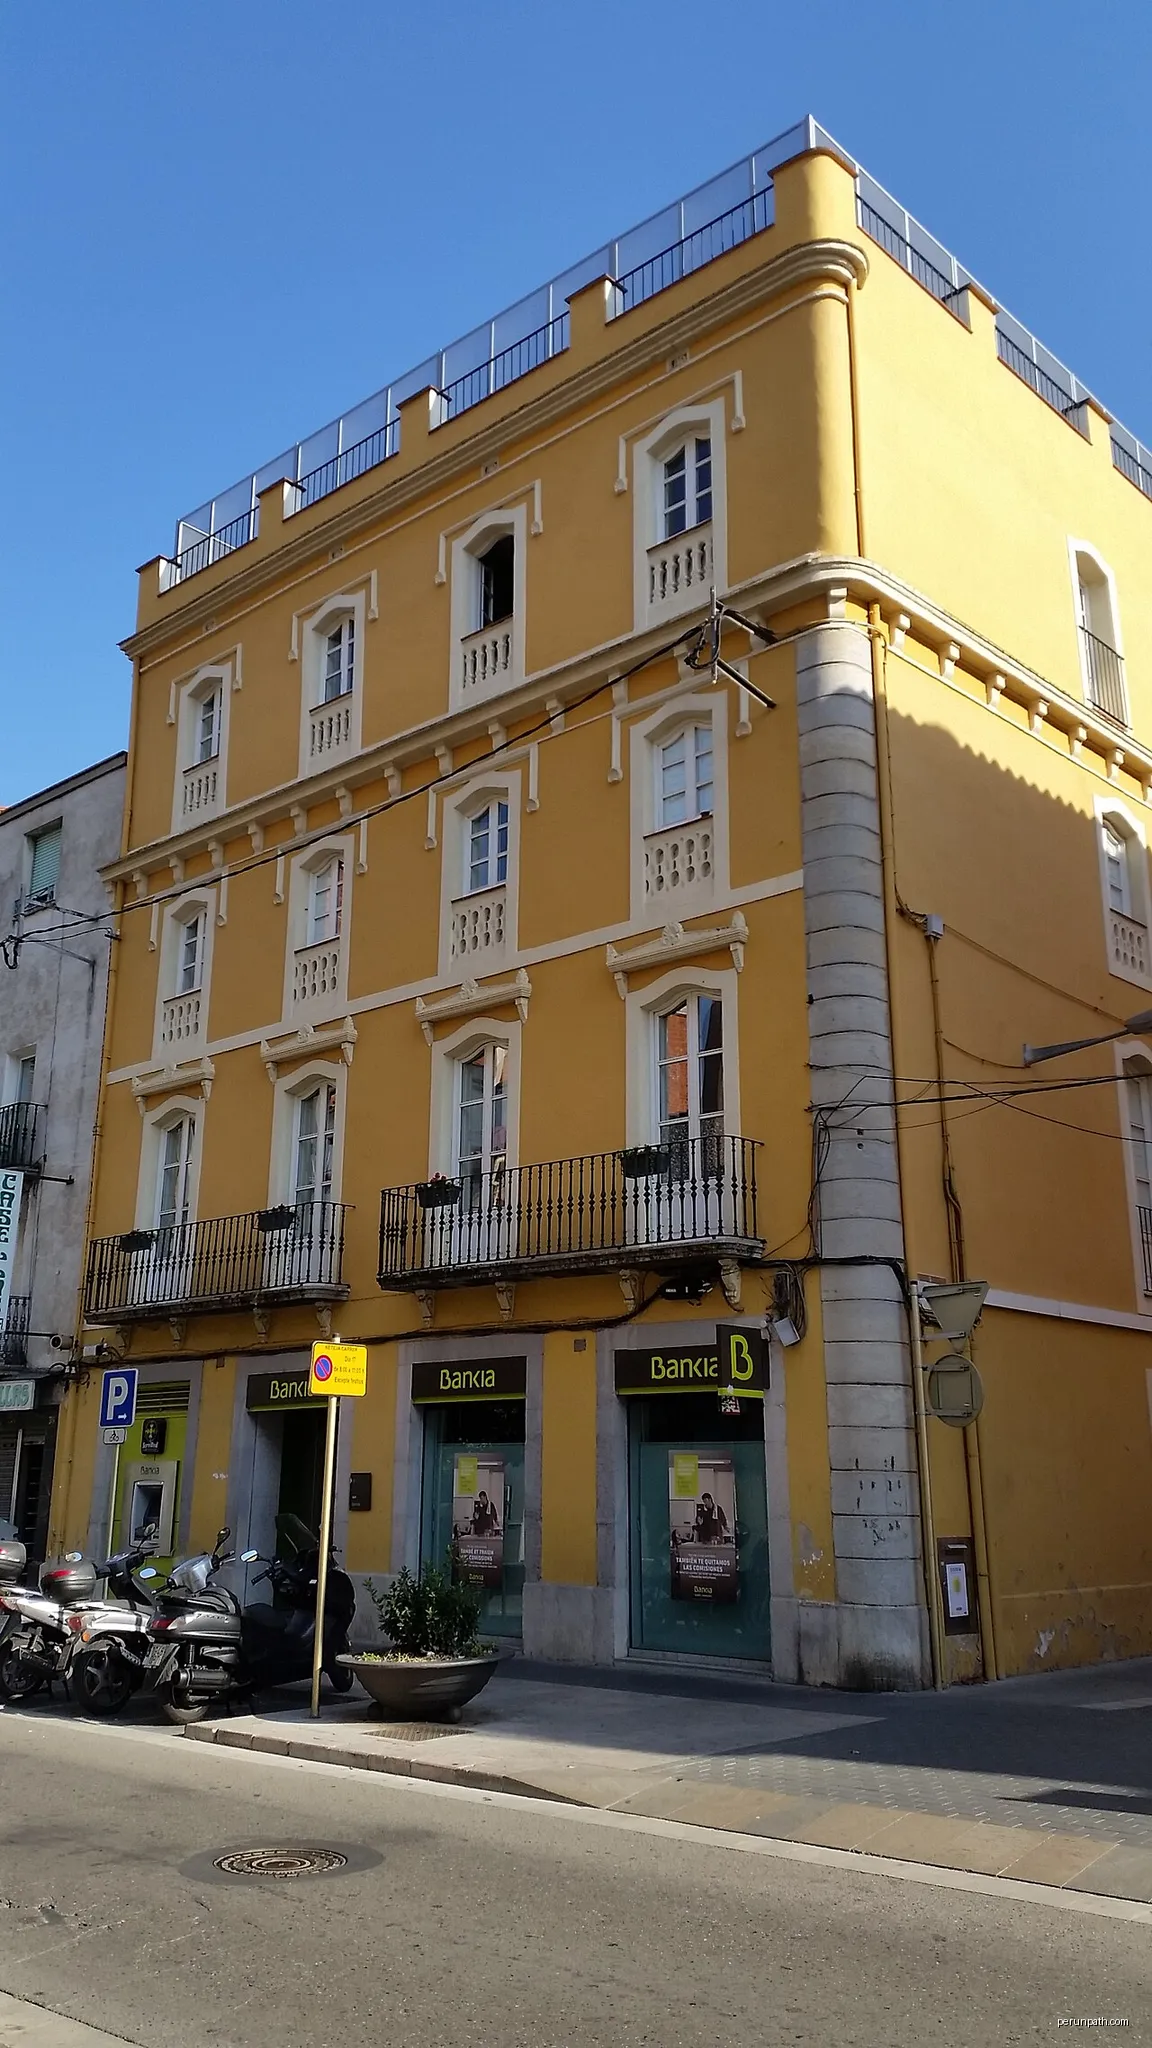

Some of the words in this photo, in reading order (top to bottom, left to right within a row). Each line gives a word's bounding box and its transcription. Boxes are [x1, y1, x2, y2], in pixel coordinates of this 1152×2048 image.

[730, 1334, 754, 1381] B
[650, 1356, 719, 1380] Bankia
[270, 1380, 309, 1399] Banki
[439, 1369, 496, 1390] Bankia
[106, 1377, 129, 1421] P
[141, 1466, 160, 1475] Bankia
[693, 1564, 723, 1573] COMISIONES
[704, 1558, 731, 1567] QUITAMOS
